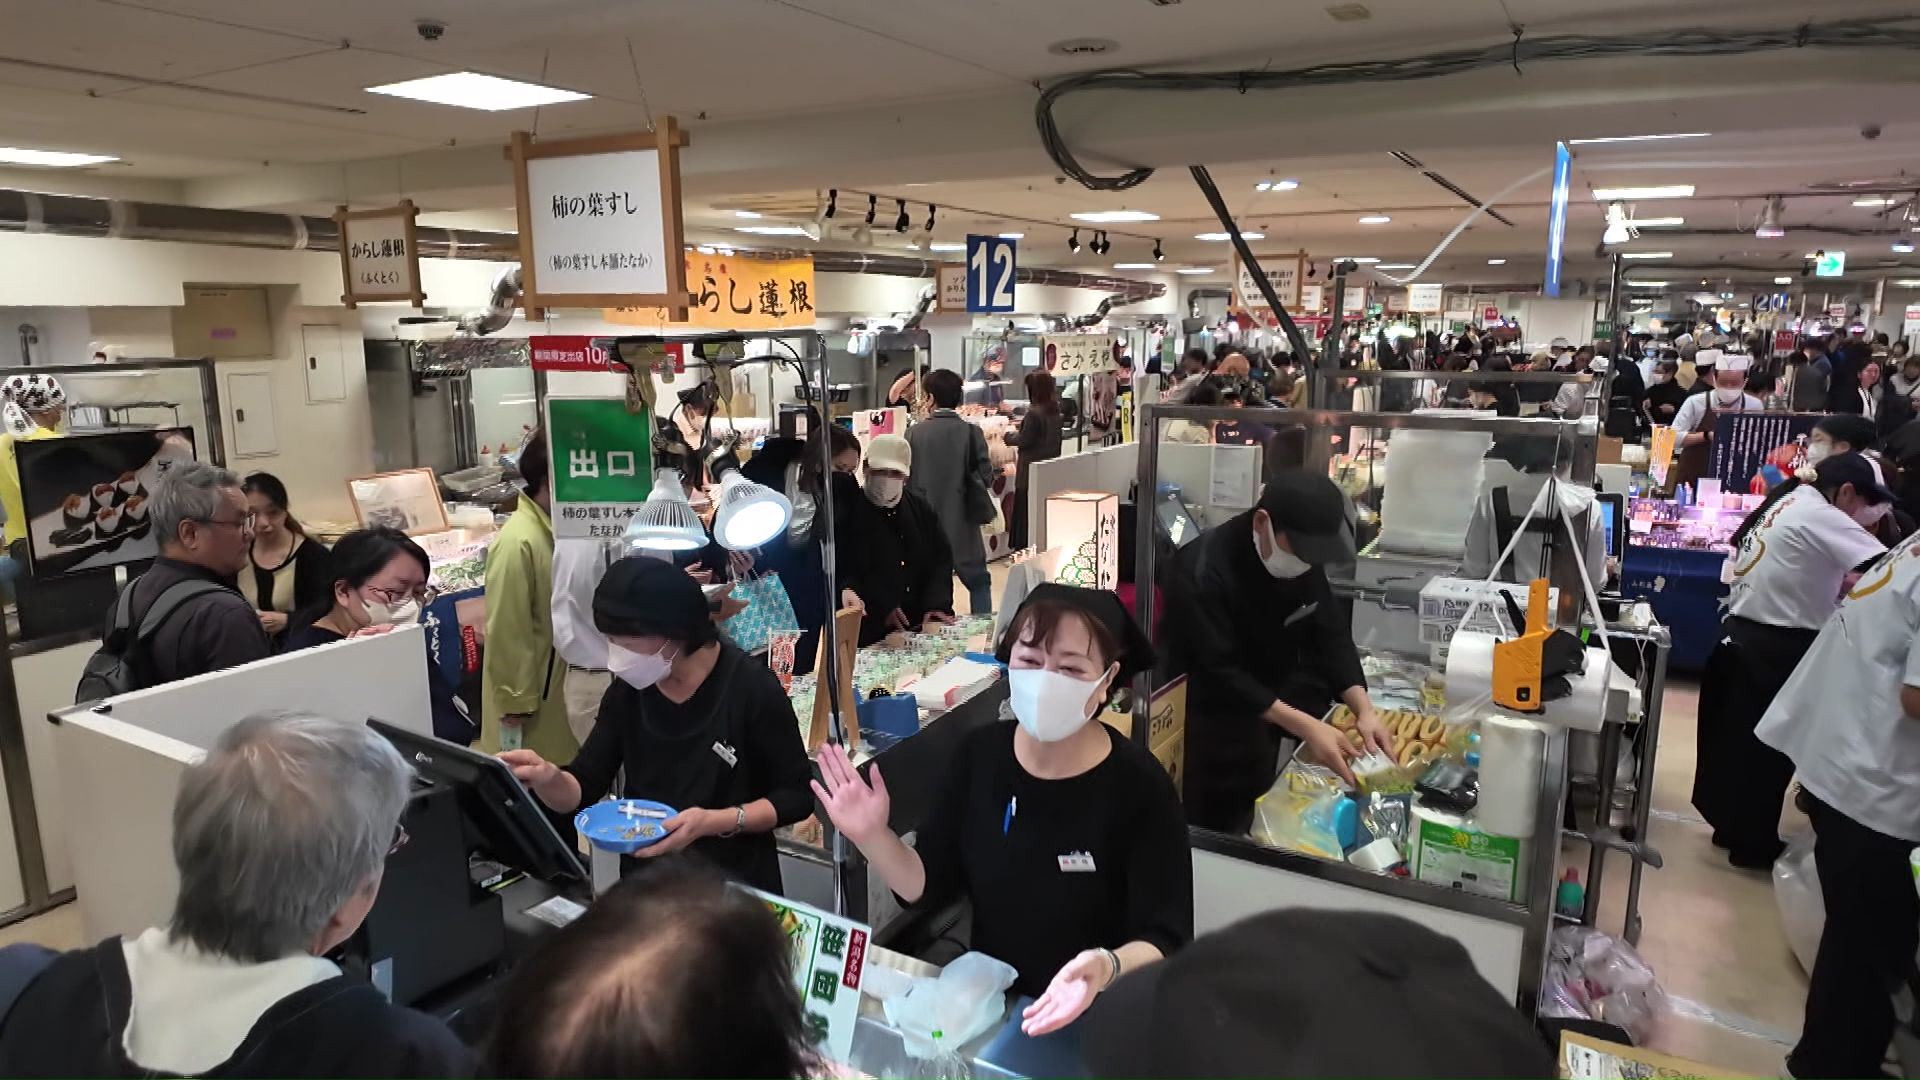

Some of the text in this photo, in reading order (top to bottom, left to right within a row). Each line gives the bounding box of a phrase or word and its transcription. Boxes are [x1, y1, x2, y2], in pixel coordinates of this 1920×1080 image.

[551, 191, 638, 218] 柿の葉すし
[351, 239, 405, 259] からし蓮根
[971, 241, 1013, 307] 12
[569, 449, 636, 479] 出口
[562, 506, 640, 520] 柿の葉すし本
[590, 523, 625, 537] たなか
